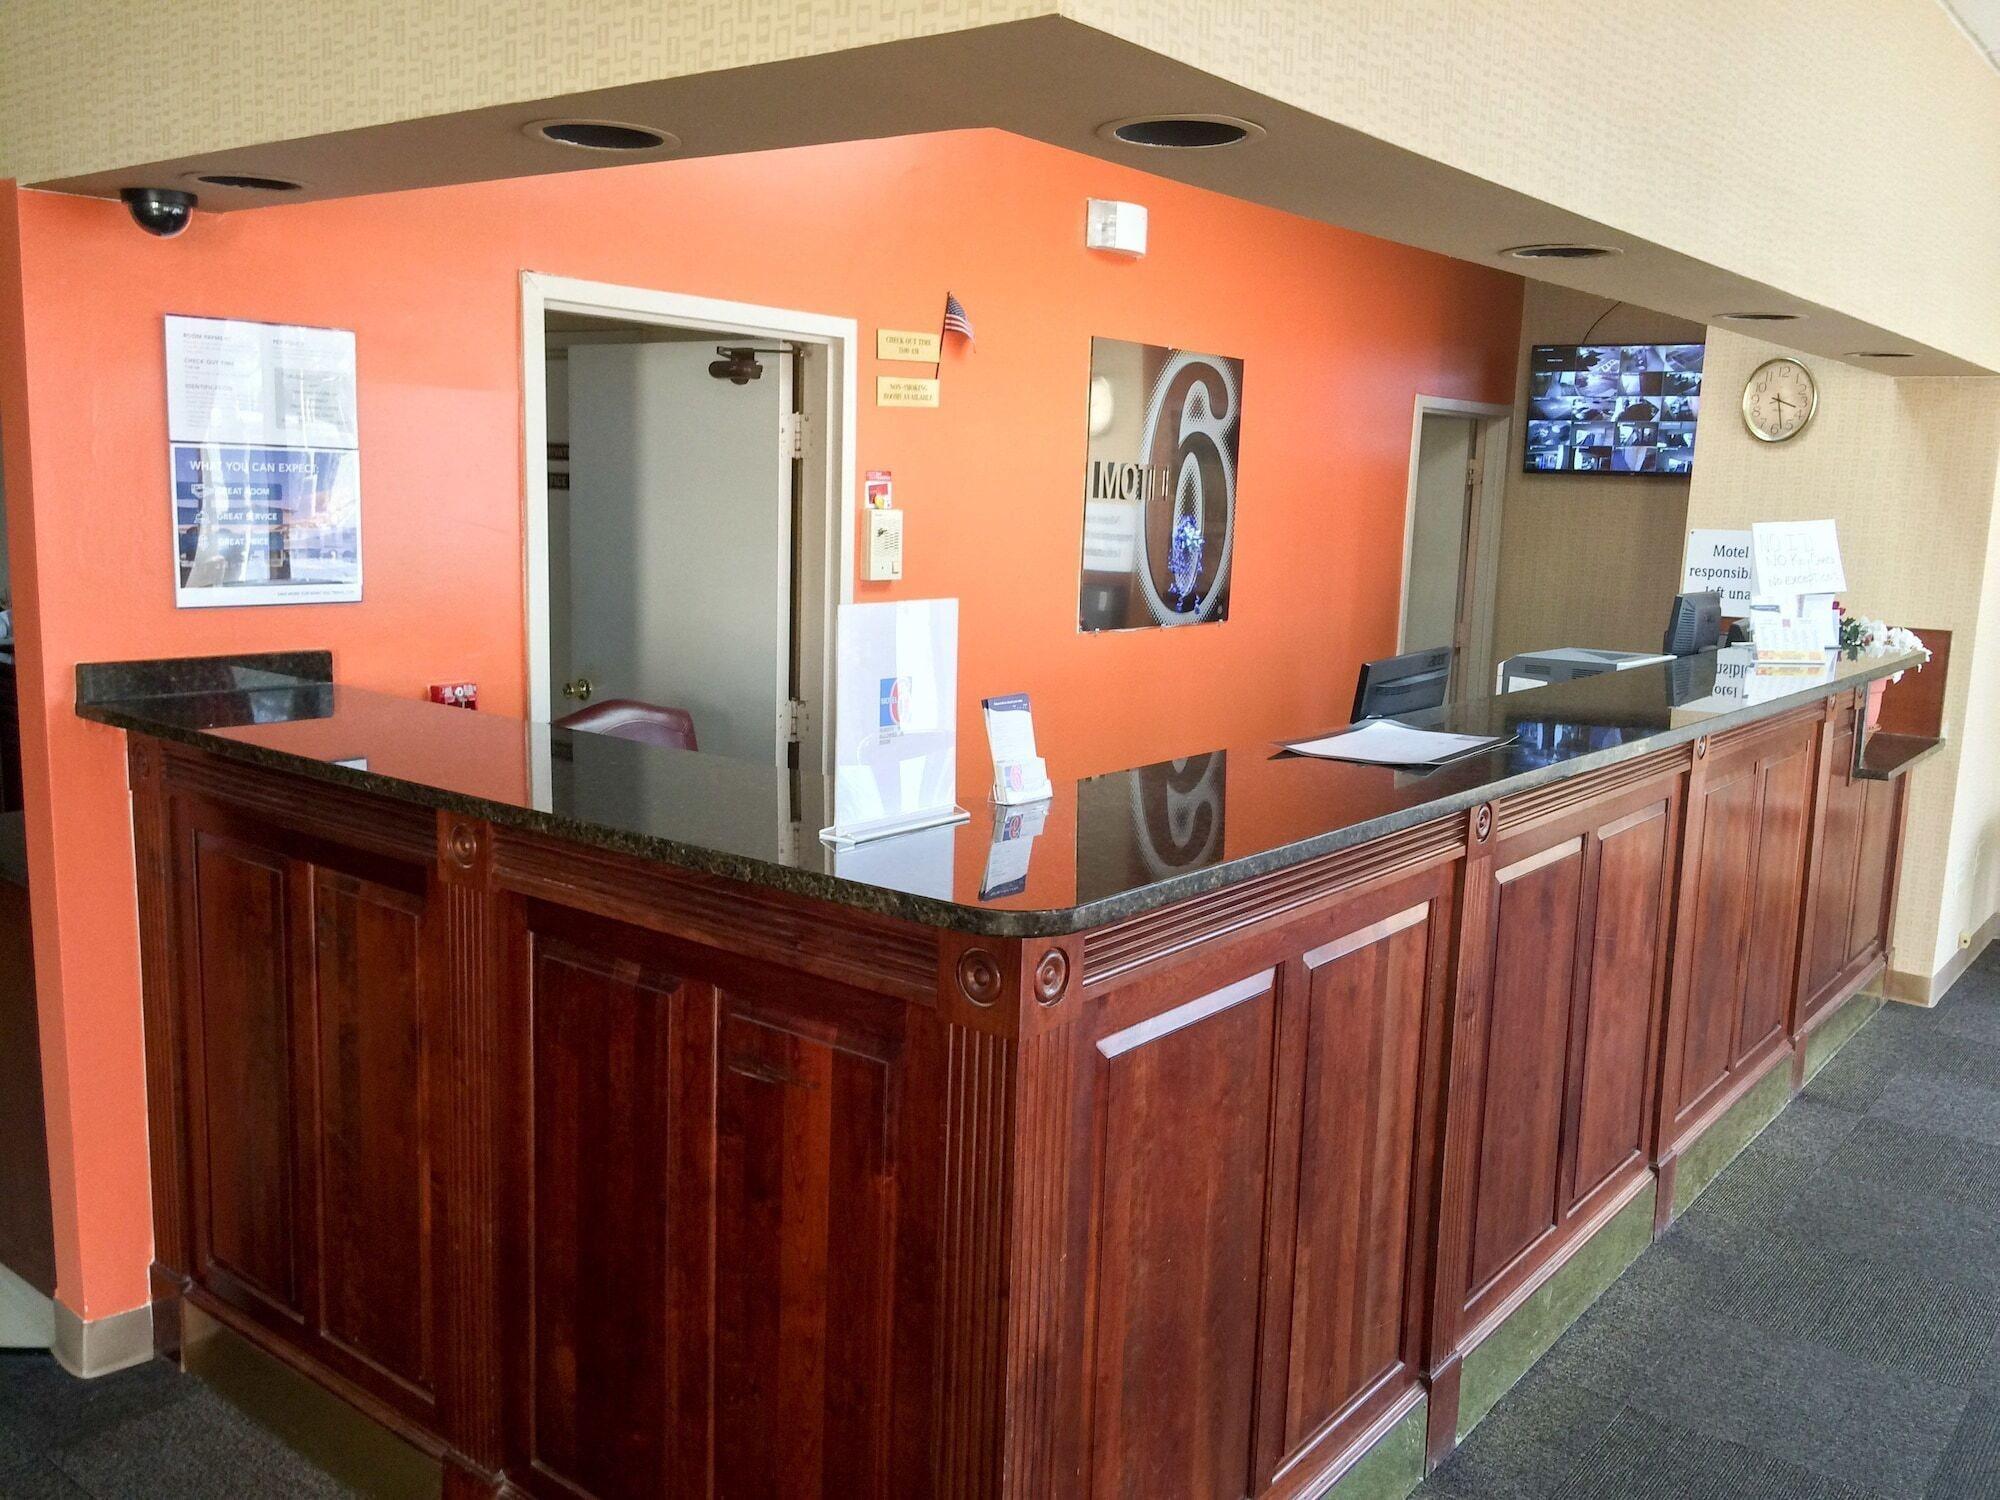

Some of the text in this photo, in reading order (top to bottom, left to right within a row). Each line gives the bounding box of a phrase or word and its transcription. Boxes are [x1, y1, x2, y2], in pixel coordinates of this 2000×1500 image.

[1778, 366, 1790, 378] 12
[1756, 382, 1767, 393] 10
[226, 461, 249, 472] YOU
[252, 462, 275, 473] CAN
[1145, 361, 1228, 613] 6
[1713, 544, 1749, 558] Motel
[1705, 586, 1724, 599] lft
